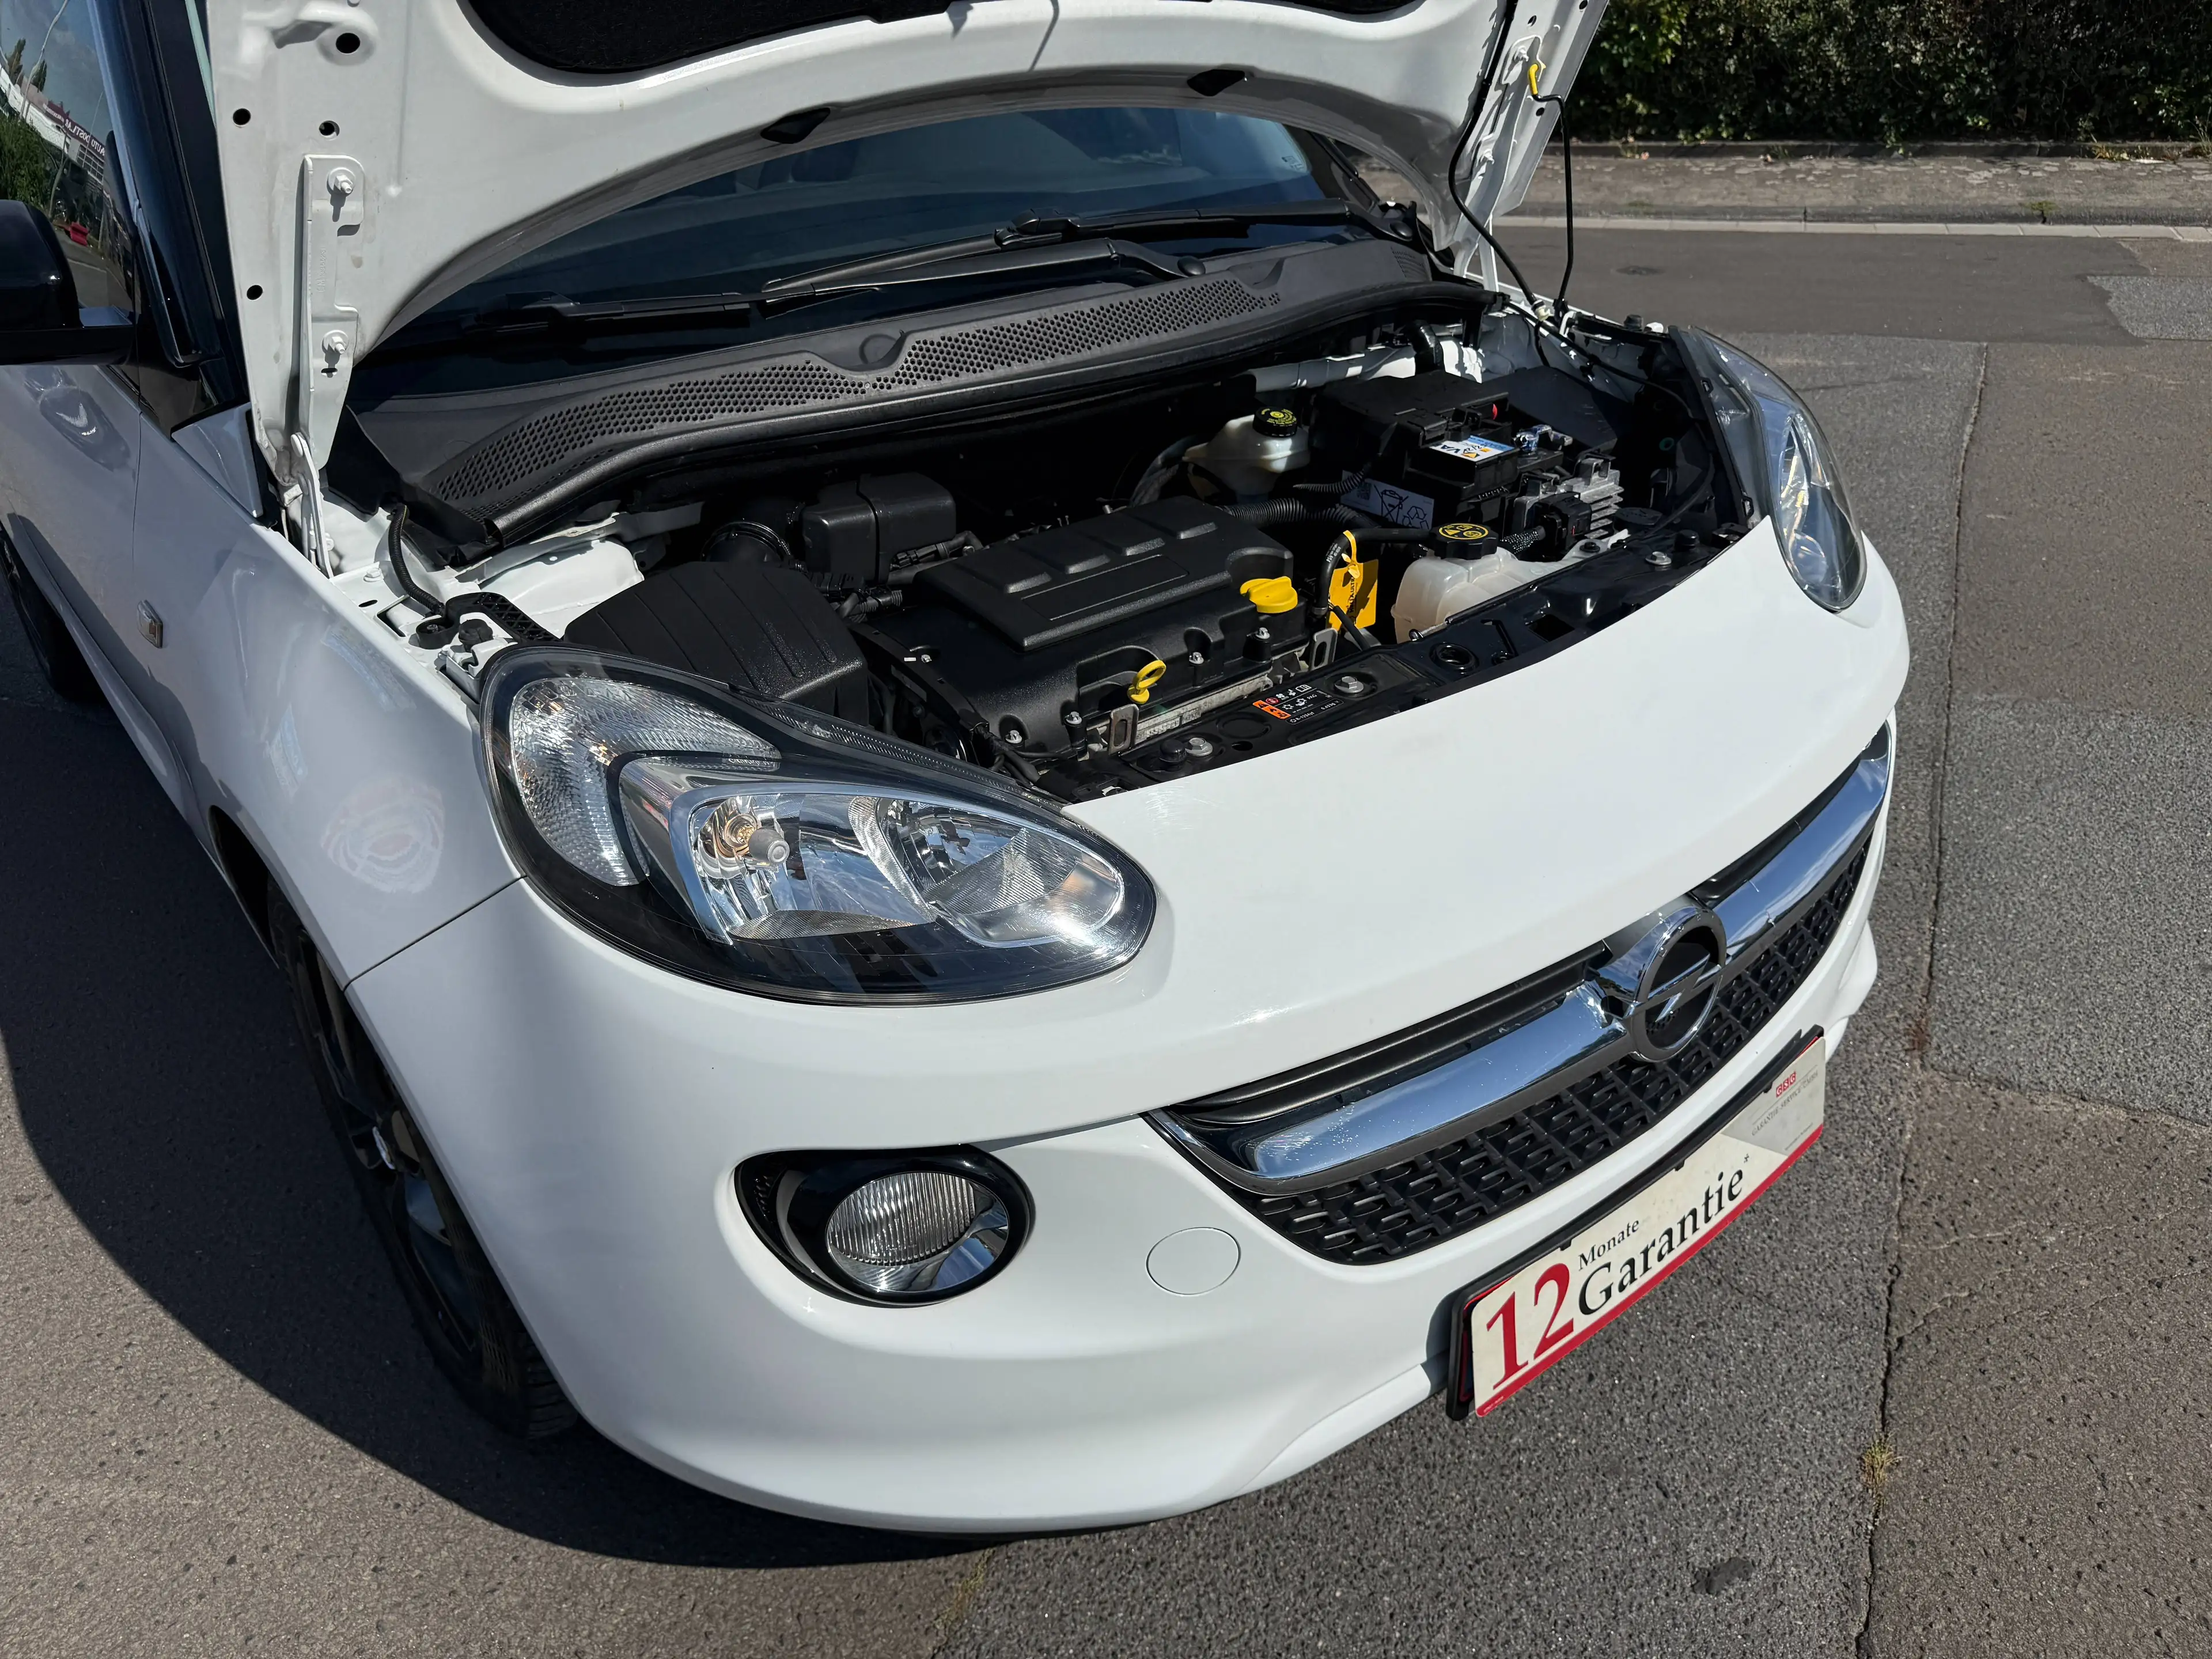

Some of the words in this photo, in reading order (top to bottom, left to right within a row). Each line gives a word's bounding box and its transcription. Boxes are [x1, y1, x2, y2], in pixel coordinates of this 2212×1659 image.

[1776, 1072, 1796, 1098] GSG
[1578, 1220, 1639, 1271] Monate
[1486, 1263, 1574, 1391] 12
